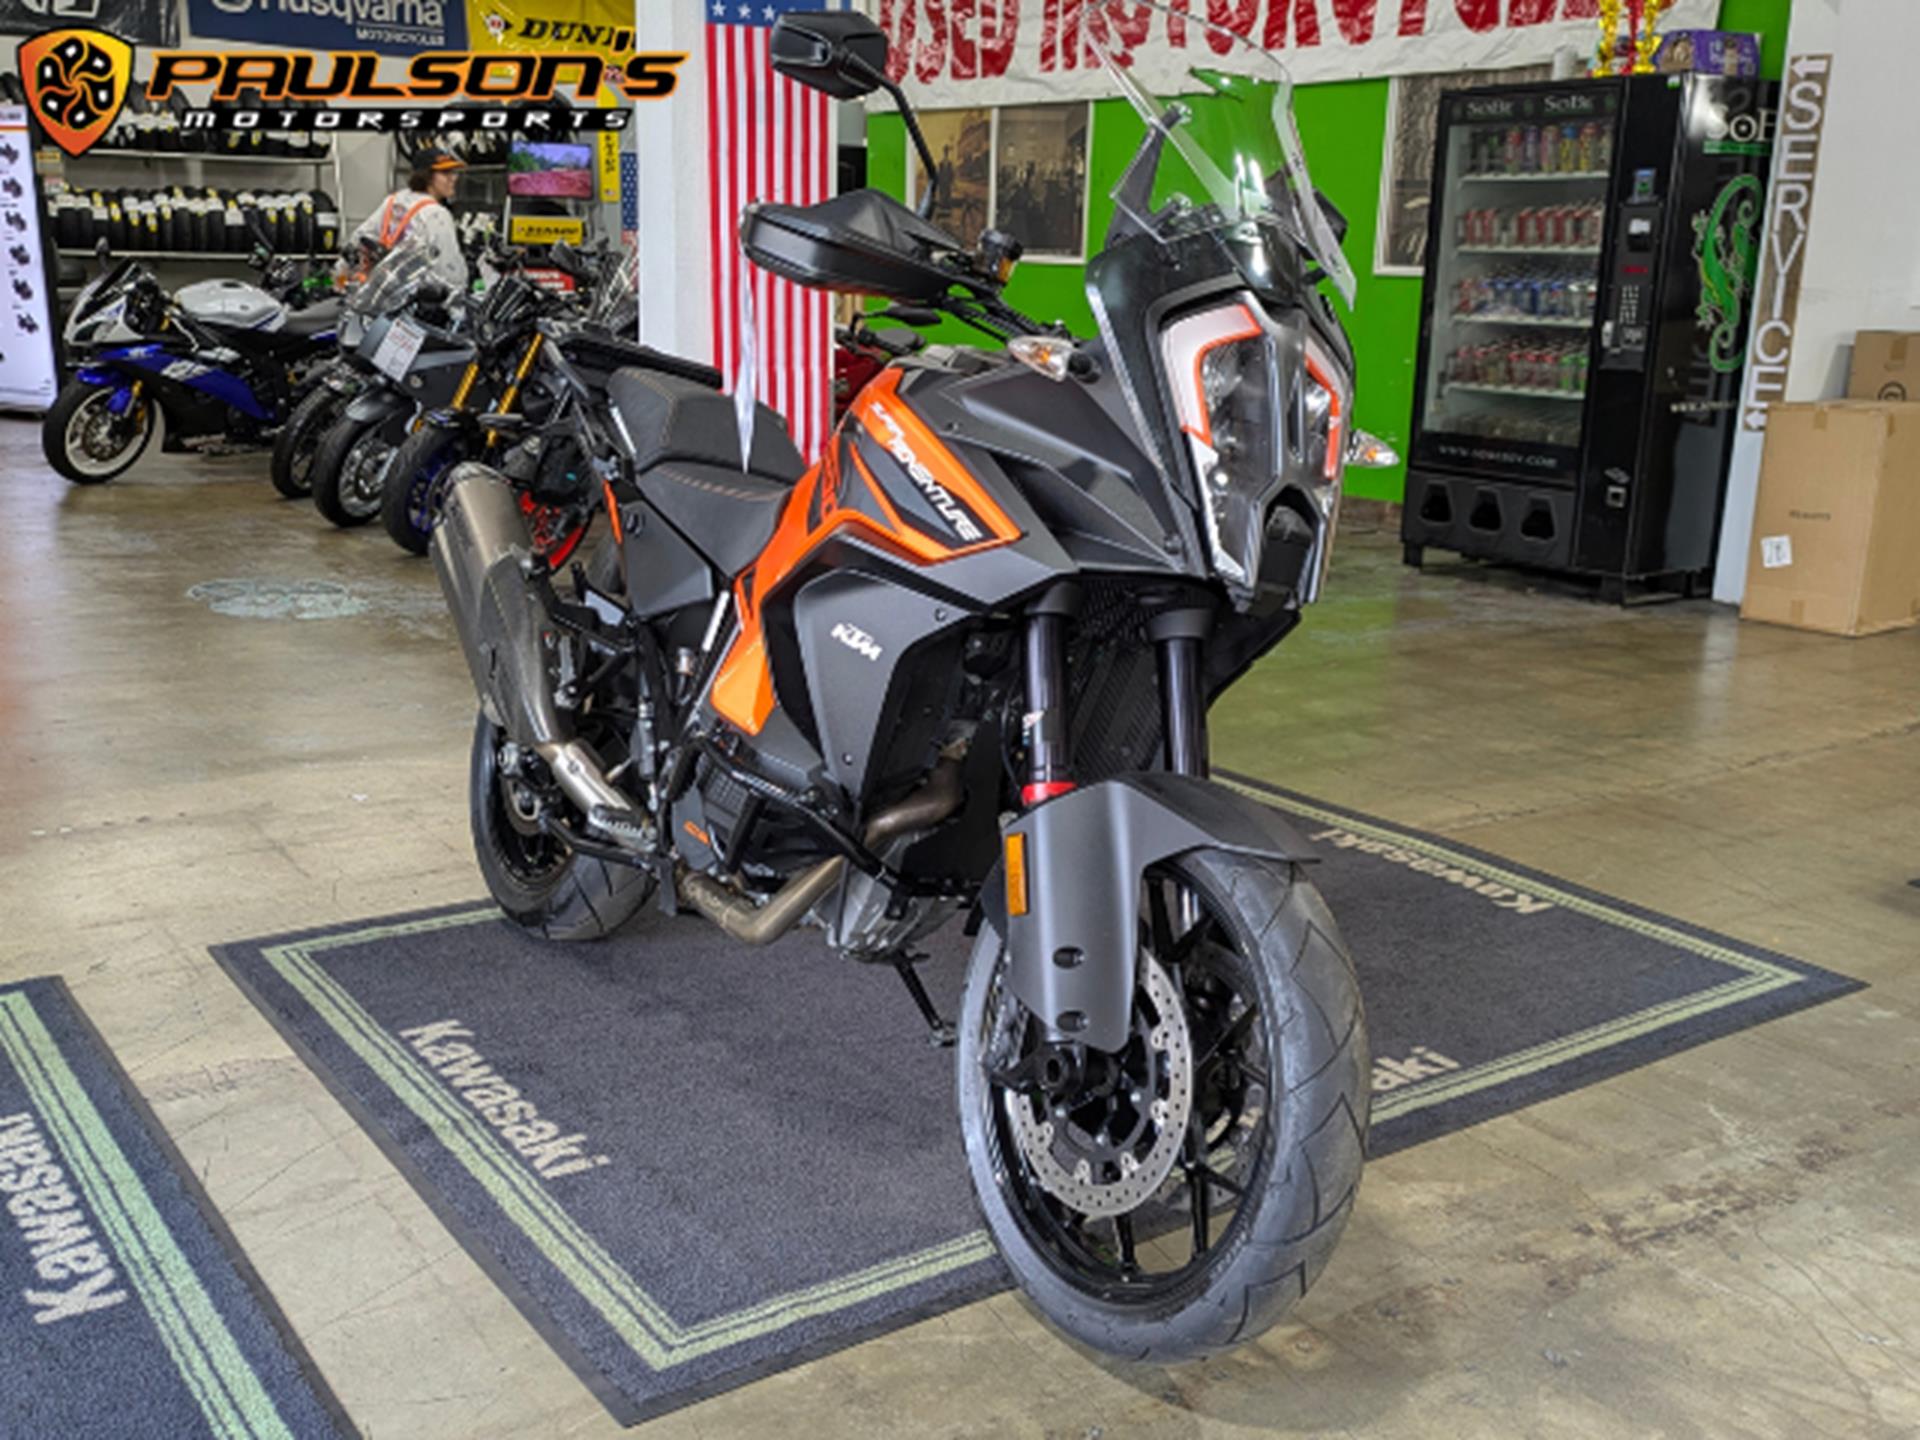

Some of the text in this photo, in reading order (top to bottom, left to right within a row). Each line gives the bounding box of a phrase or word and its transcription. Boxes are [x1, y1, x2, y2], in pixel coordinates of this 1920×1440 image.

[1747, 80, 1823, 408] SERVICE
[886, 437, 983, 542] ADVENTURE
[830, 622, 884, 662] KTM
[398, 1018, 612, 1181] Kawasaki
